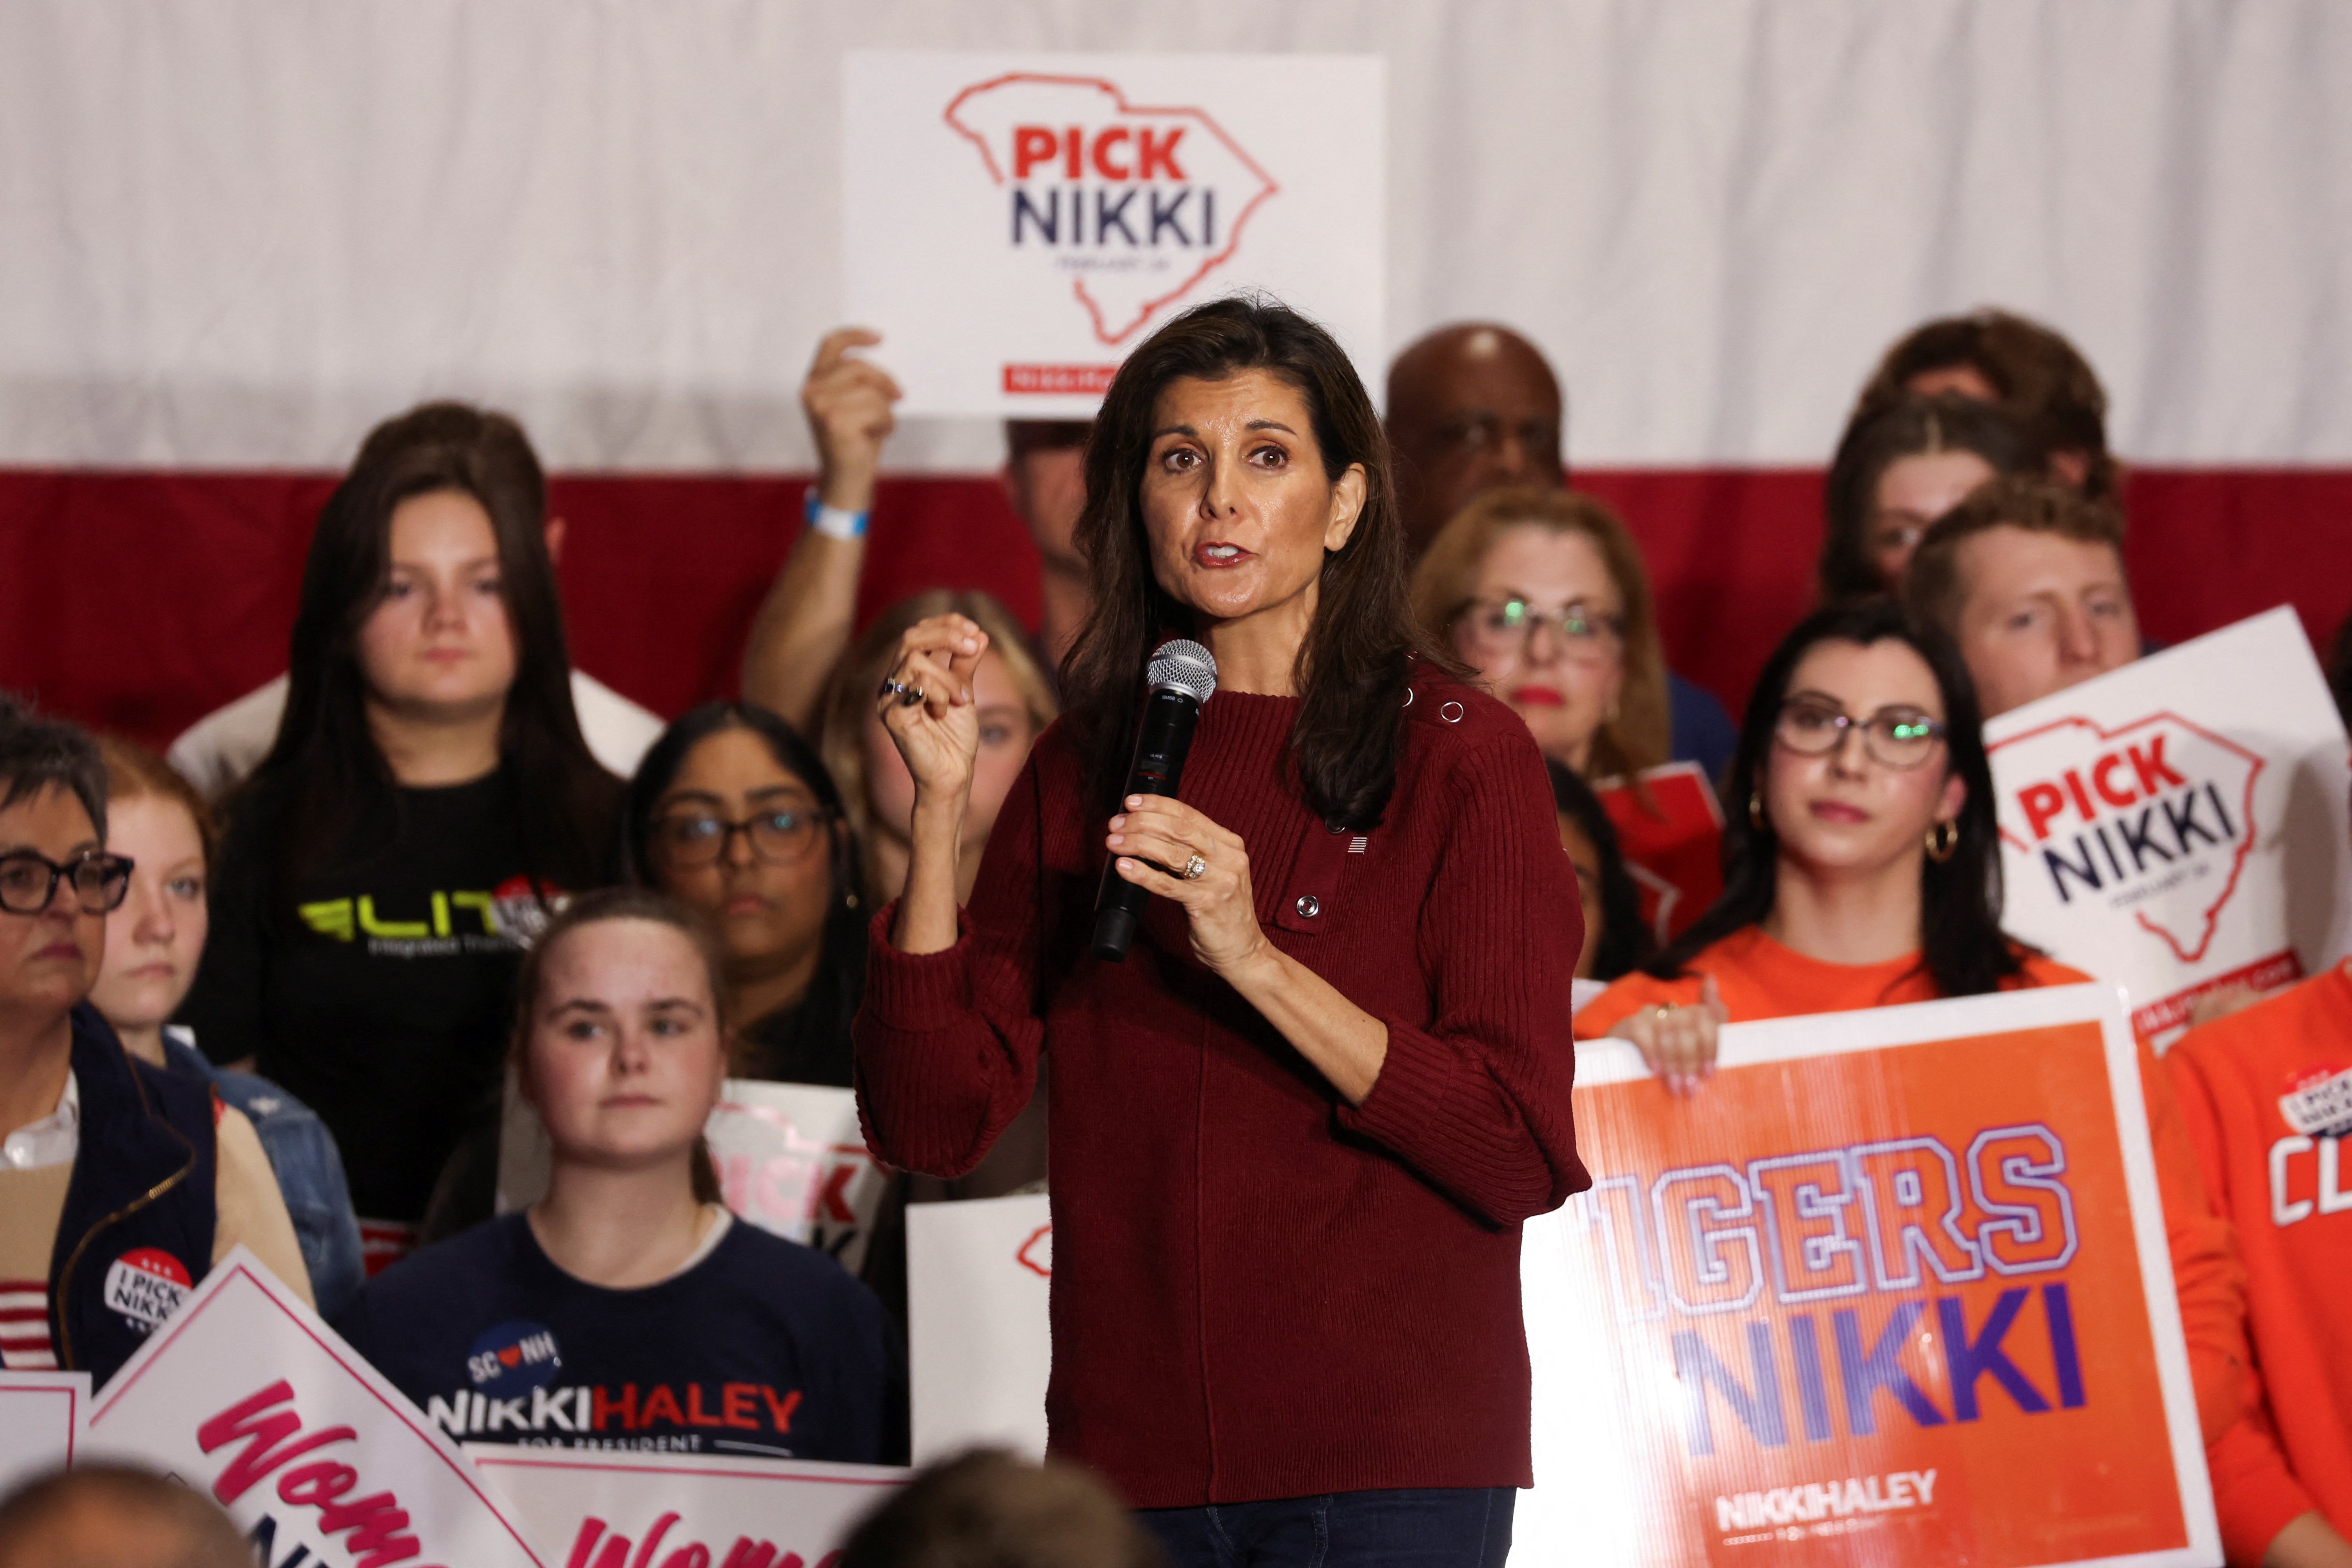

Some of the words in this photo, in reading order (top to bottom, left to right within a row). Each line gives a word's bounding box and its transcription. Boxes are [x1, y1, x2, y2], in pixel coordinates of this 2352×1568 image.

[1013, 125, 1188, 180] PICK
[1011, 188, 1216, 246] NIKKI
[2017, 734, 2187, 840] PICK
[2042, 781, 2235, 902] NIKKI
[708, 1150, 858, 1223] ICK
[1577, 1122, 2077, 1320] IGERS
[133, 1273, 181, 1306] PICK
[468, 1351, 501, 1383] SC
[519, 1331, 556, 1365] NH
[1671, 1282, 2087, 1456] NIKKI
[427, 1383, 803, 1437] NIKKIHALEY
[574, 1434, 702, 1451] PRESIDENT
[1716, 1468, 1937, 1532] NIKKIHALEY
